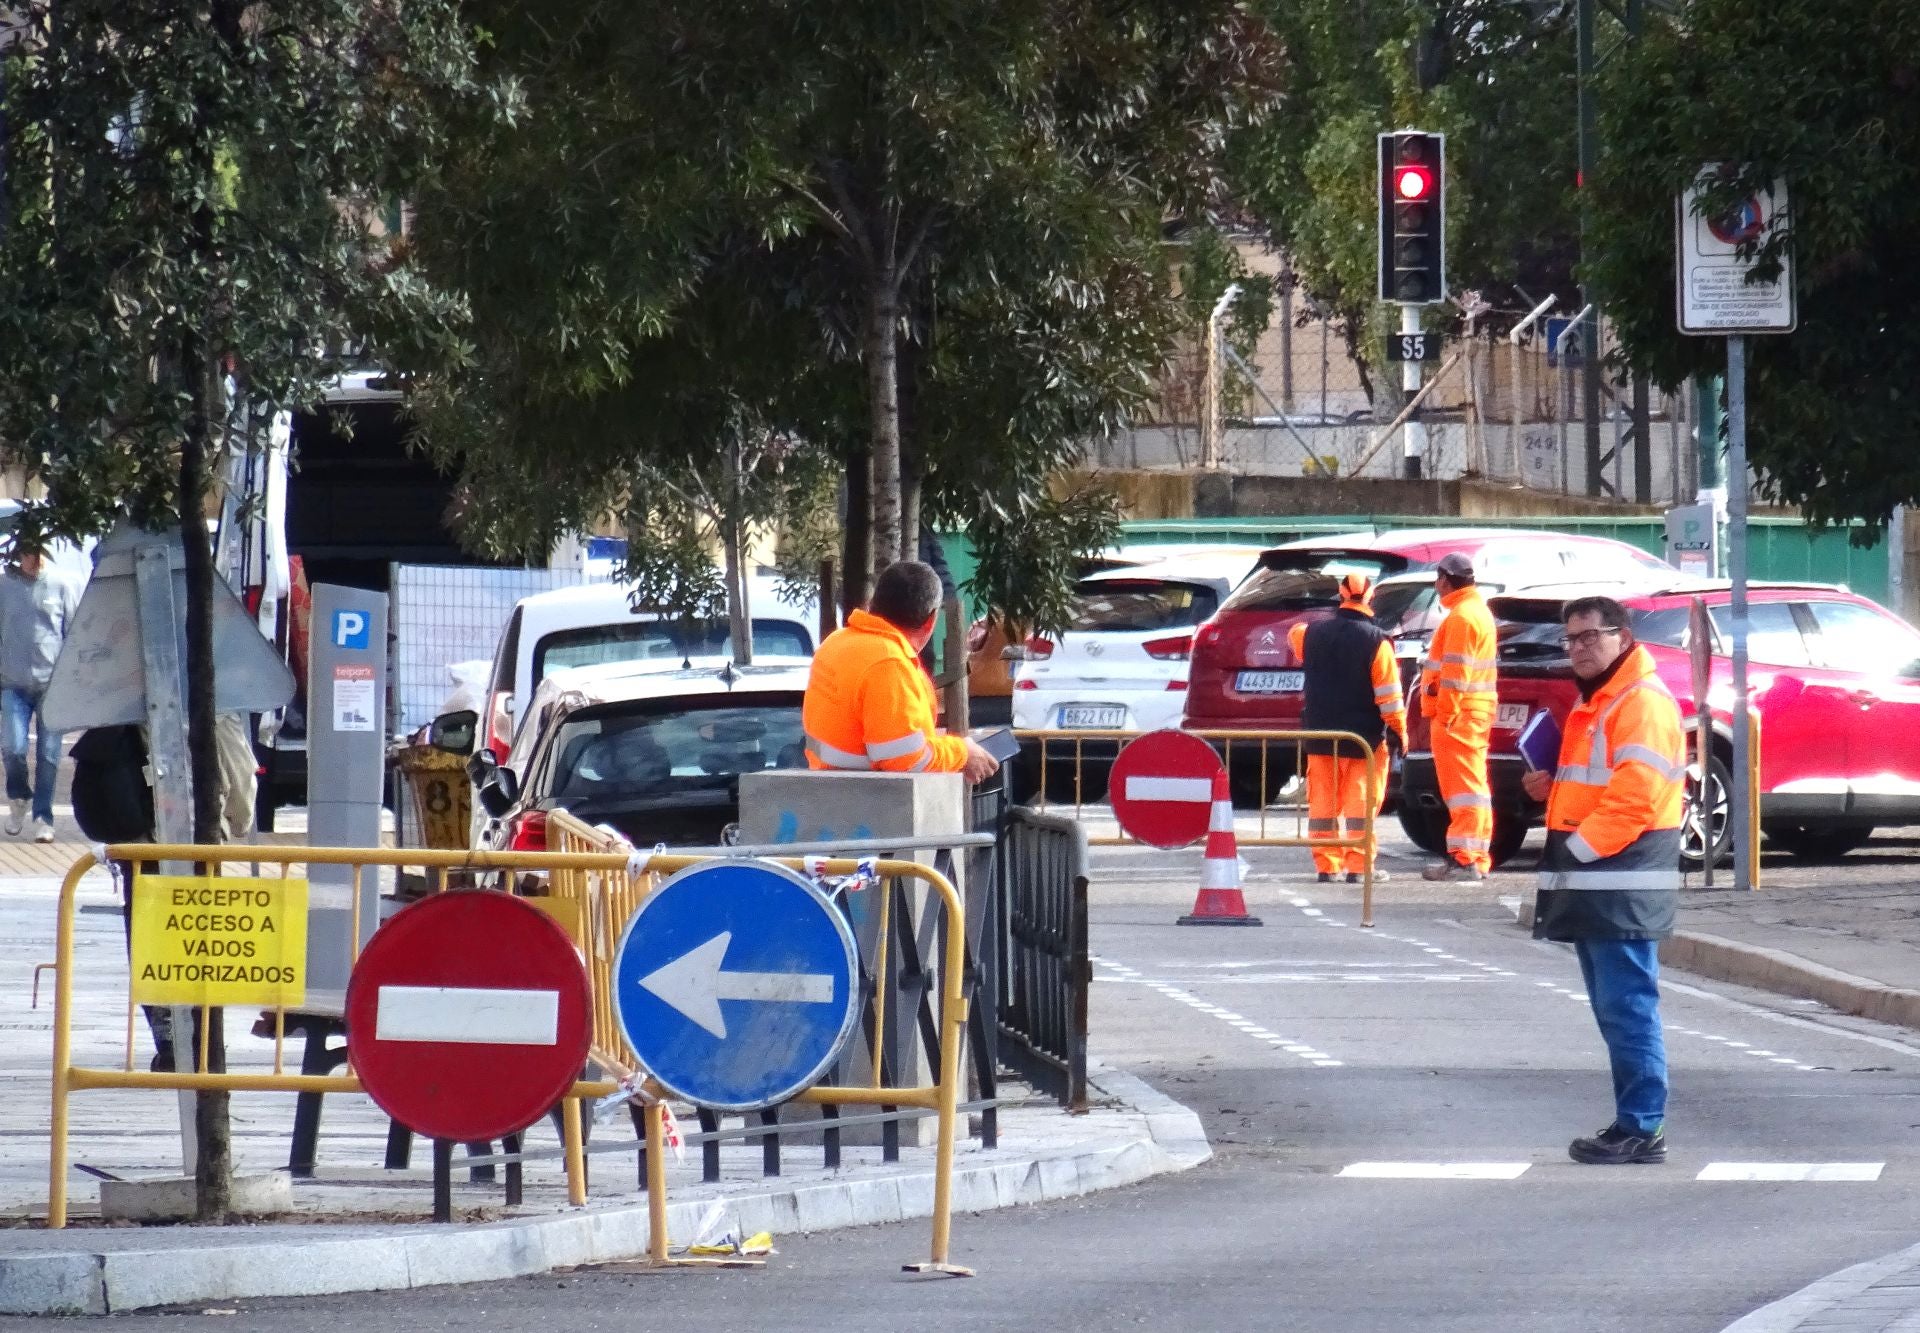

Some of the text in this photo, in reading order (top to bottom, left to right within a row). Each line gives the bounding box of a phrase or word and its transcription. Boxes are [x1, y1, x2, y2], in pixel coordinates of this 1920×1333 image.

[1402, 336, 1425, 359] S5
[337, 612, 364, 646] P
[1244, 673, 1301, 688] 4433 HSC
[1066, 709, 1121, 724] 6622 KYT
[172, 888, 271, 908] EXCEPTO
[165, 914, 275, 932] ACCESO A
[182, 939, 255, 957] VADOS
[141, 964, 295, 984] AUTORIZADOS
